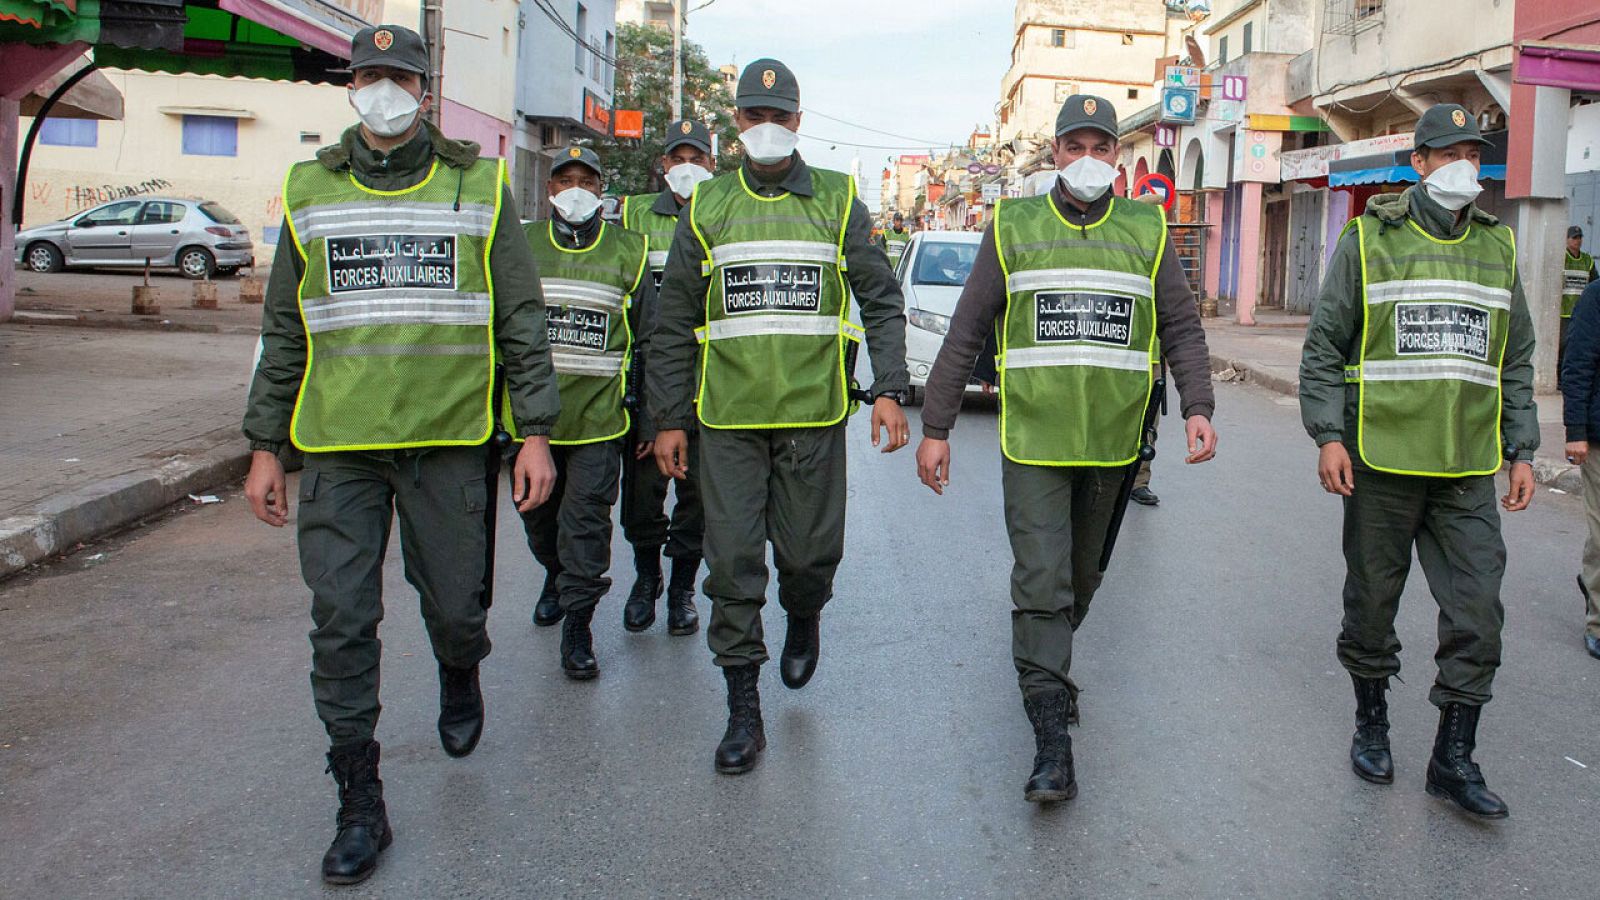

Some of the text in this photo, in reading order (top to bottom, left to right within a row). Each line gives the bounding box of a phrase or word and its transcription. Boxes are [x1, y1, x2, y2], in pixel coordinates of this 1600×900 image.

[332, 240, 451, 262] القوات المساعدة
[334, 265, 451, 287] FORCES AUXILIAIRES
[727, 269, 817, 289] القوات المساعدة
[728, 290, 817, 309] FORCES AUXILIAIRES
[1040, 298, 1131, 320] القوات المساعدة
[1401, 310, 1459, 326] المساعدة
[557, 327, 604, 346] AUXILIAIRES
[1040, 320, 1128, 340] FORCES AUXILIAIRES
[1400, 332, 1440, 349] FORCES
